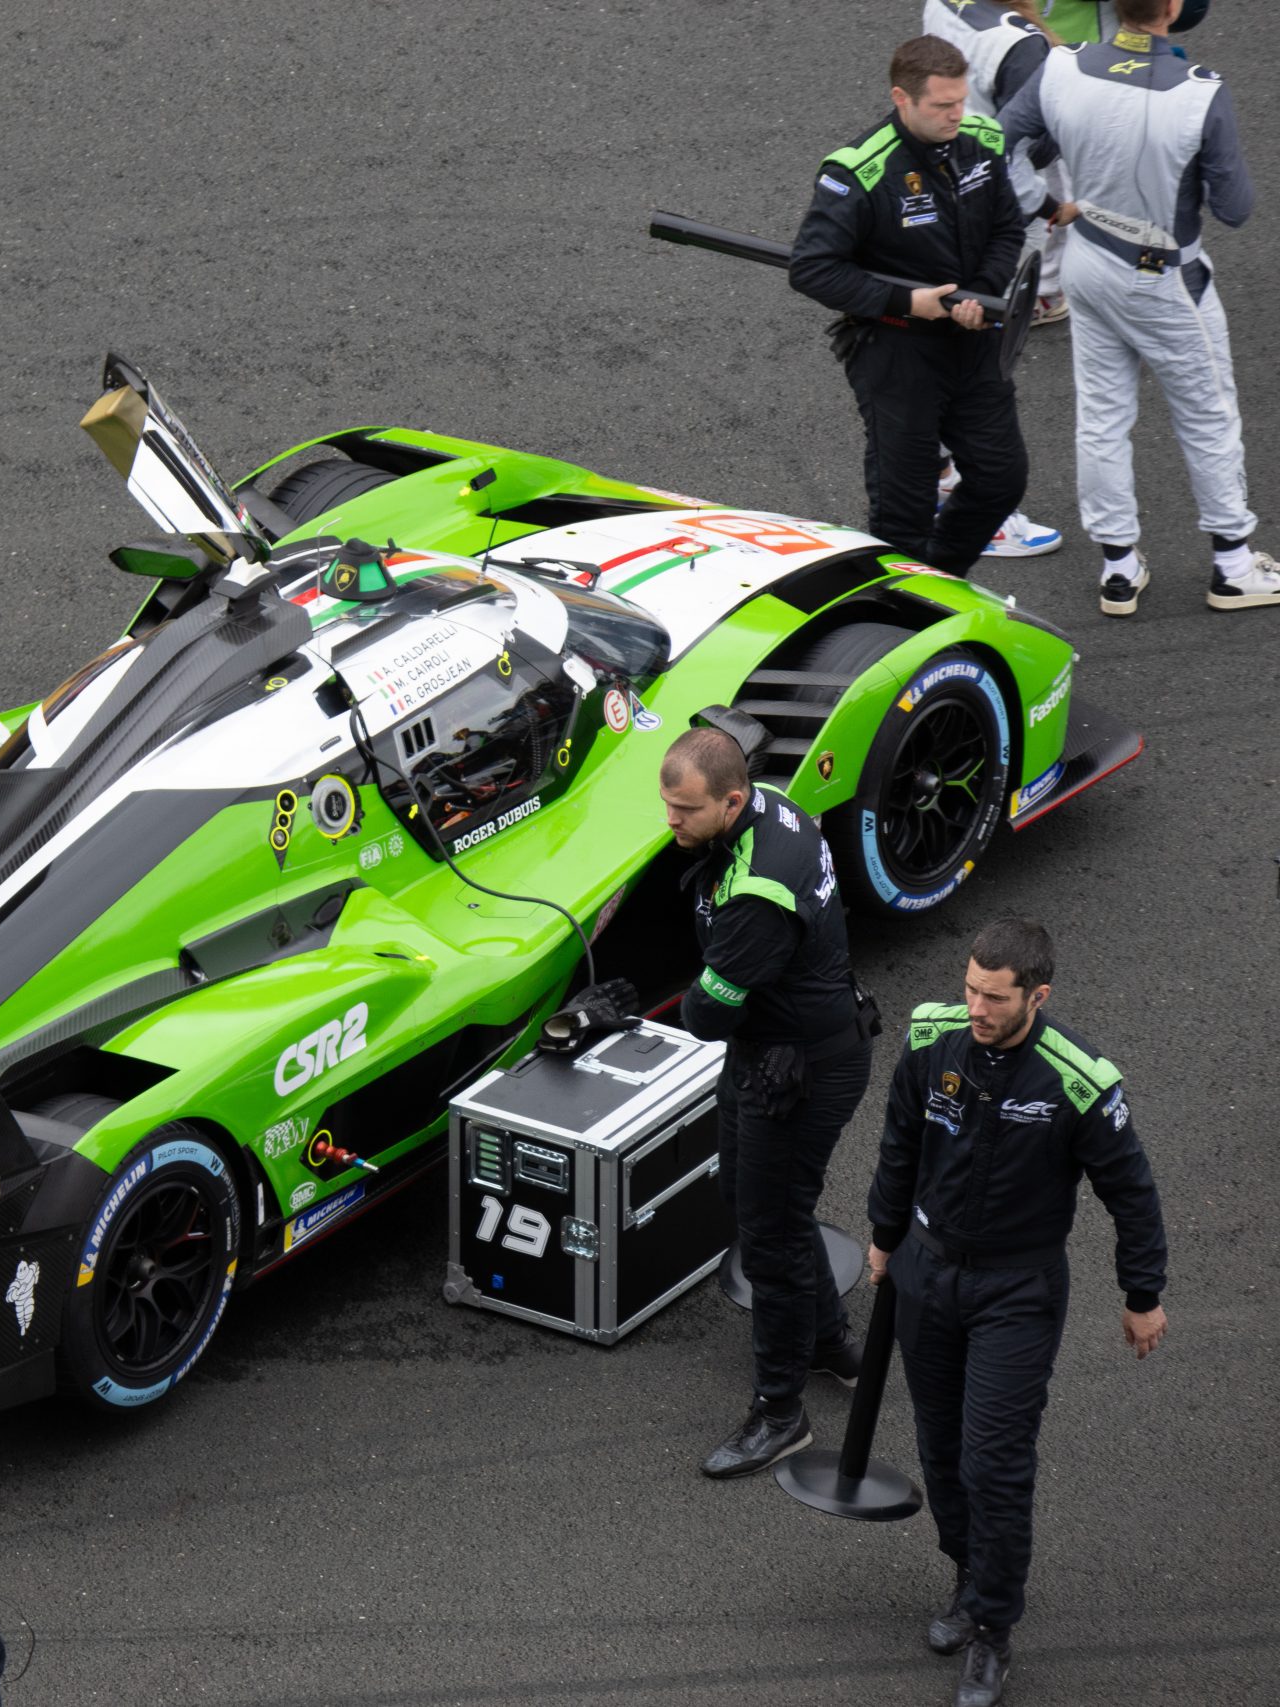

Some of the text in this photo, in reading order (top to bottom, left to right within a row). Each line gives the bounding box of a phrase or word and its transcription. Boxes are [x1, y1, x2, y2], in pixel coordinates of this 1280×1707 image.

[393, 624, 458, 668] CALDARELLI
[407, 649, 451, 681] CAIROLI
[416, 657, 472, 698] GROSJEAN
[923, 663, 980, 691] MICHELIN
[610, 700, 624, 723] E
[453, 796, 541, 854] ROGER DUBUIS
[896, 880, 956, 910] MICHELIN
[274, 1001, 369, 1097] CSR2
[914, 1027, 933, 1039] OMP
[1071, 1081, 1091, 1100] OMP
[1001, 1098, 1059, 1116] WEC
[157, 1147, 198, 1160] PILOT SPORT
[91, 1161, 147, 1250] MICHELIN
[307, 1188, 357, 1228] MICHELIN
[476, 1195, 552, 1258] 19
